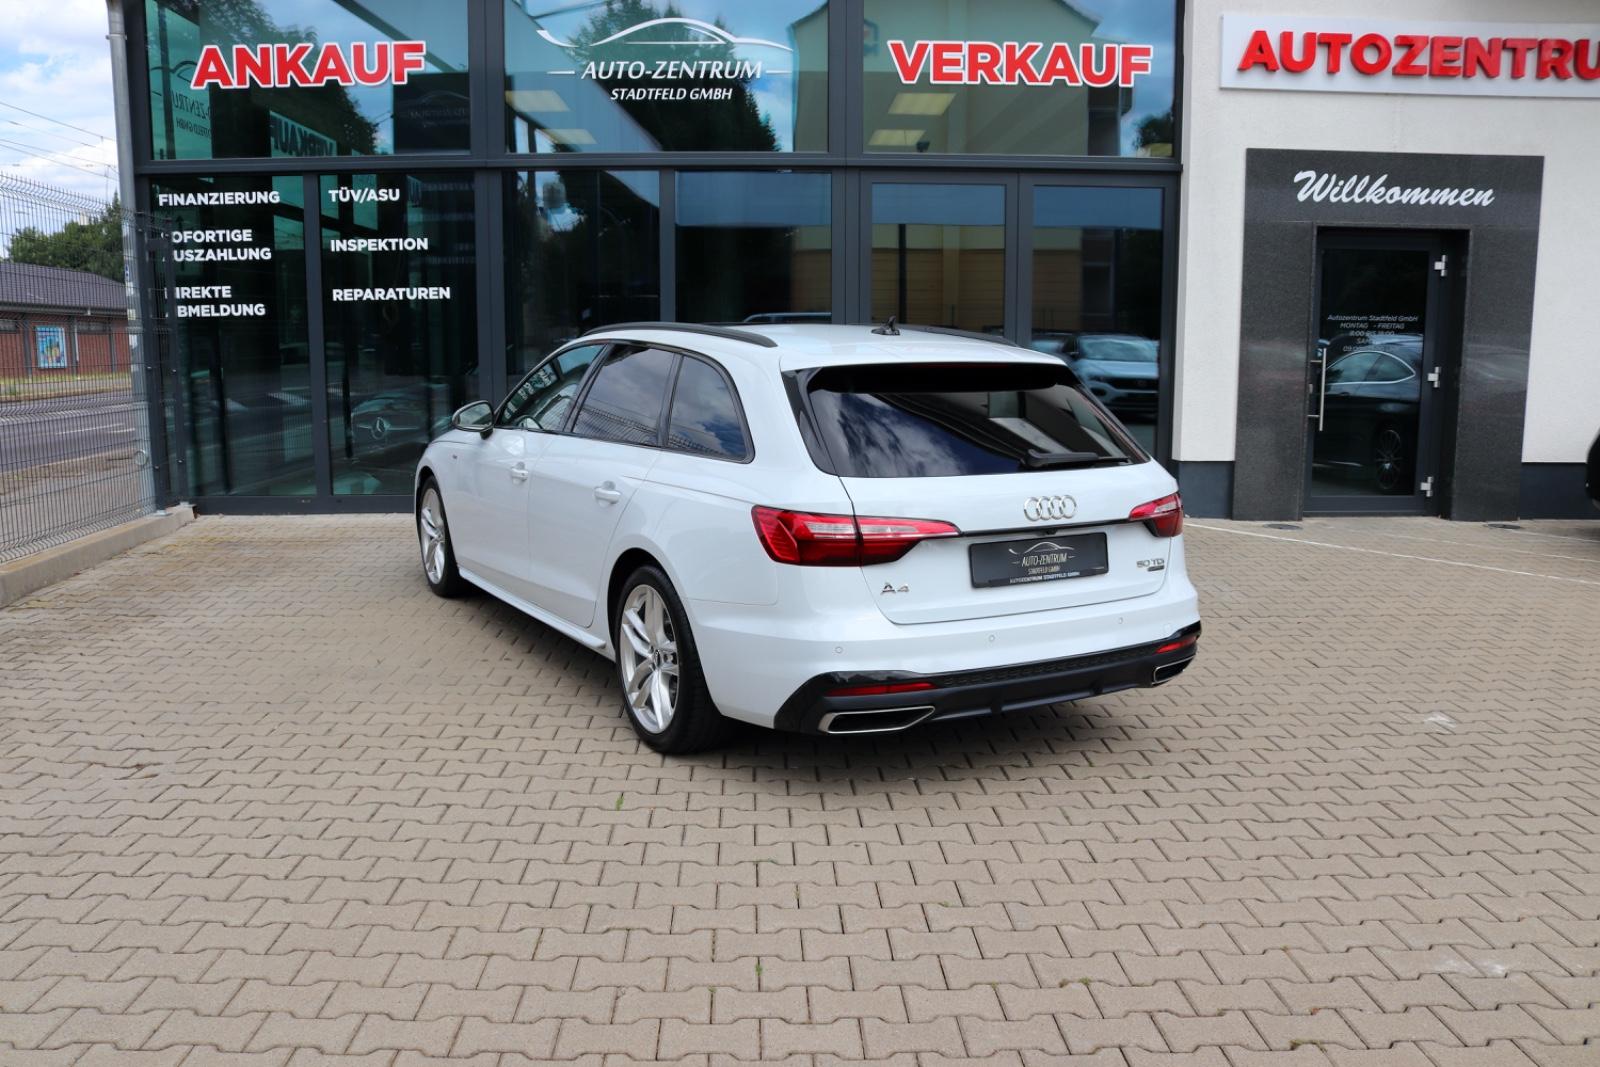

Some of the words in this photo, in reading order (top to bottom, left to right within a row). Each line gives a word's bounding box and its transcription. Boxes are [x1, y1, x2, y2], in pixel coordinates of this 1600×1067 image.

[191, 41, 425, 89] ANKAUF
[581, 60, 763, 81] AUTO-ZENTRUM
[888, 40, 1152, 88] VERKAUF
[610, 87, 687, 101] STADTFELD
[689, 87, 733, 101] GMBH
[328, 186, 401, 203] TÜV/ASU
[1293, 169, 1495, 207] Willkommen
[158, 190, 280, 207] FINANZIERUNG
[161, 228, 253, 243] OFORTIGE
[330, 237, 429, 252] INSPEKTION
[162, 247, 272, 262] USZAHLUNG
[332, 286, 451, 301] REPARATUREN
[165, 303, 266, 318] BMELDUNG
